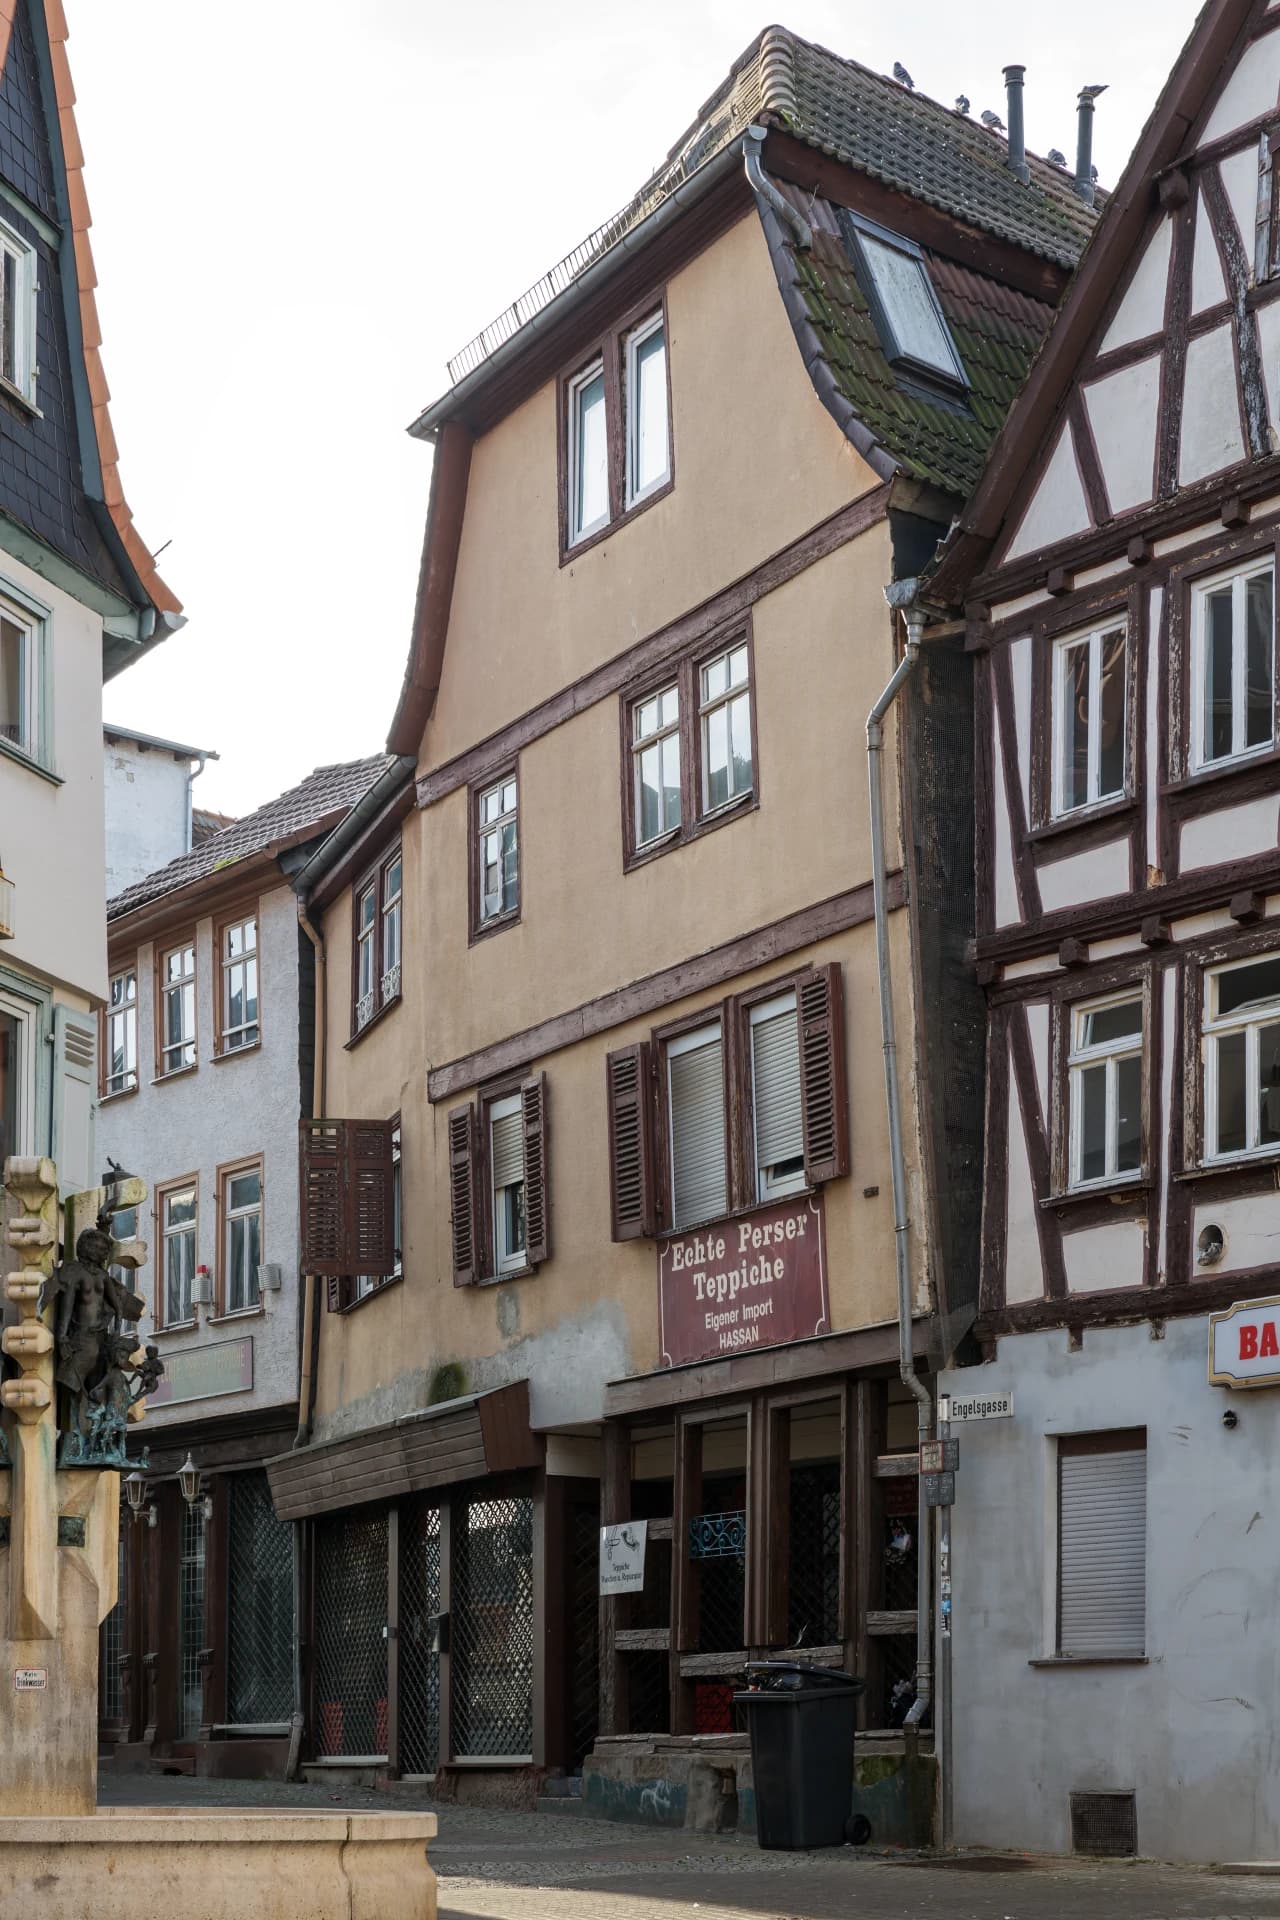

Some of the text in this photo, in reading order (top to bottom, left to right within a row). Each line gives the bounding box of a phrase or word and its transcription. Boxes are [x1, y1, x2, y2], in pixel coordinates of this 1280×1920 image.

[672, 1213, 808, 1272] Echte Perser
[693, 1255, 785, 1303] Teppiche
[705, 1298, 774, 1332] Eigener Import
[719, 1325, 759, 1349] HASSAN
[952, 1399, 1008, 1419] Engelsgasse
